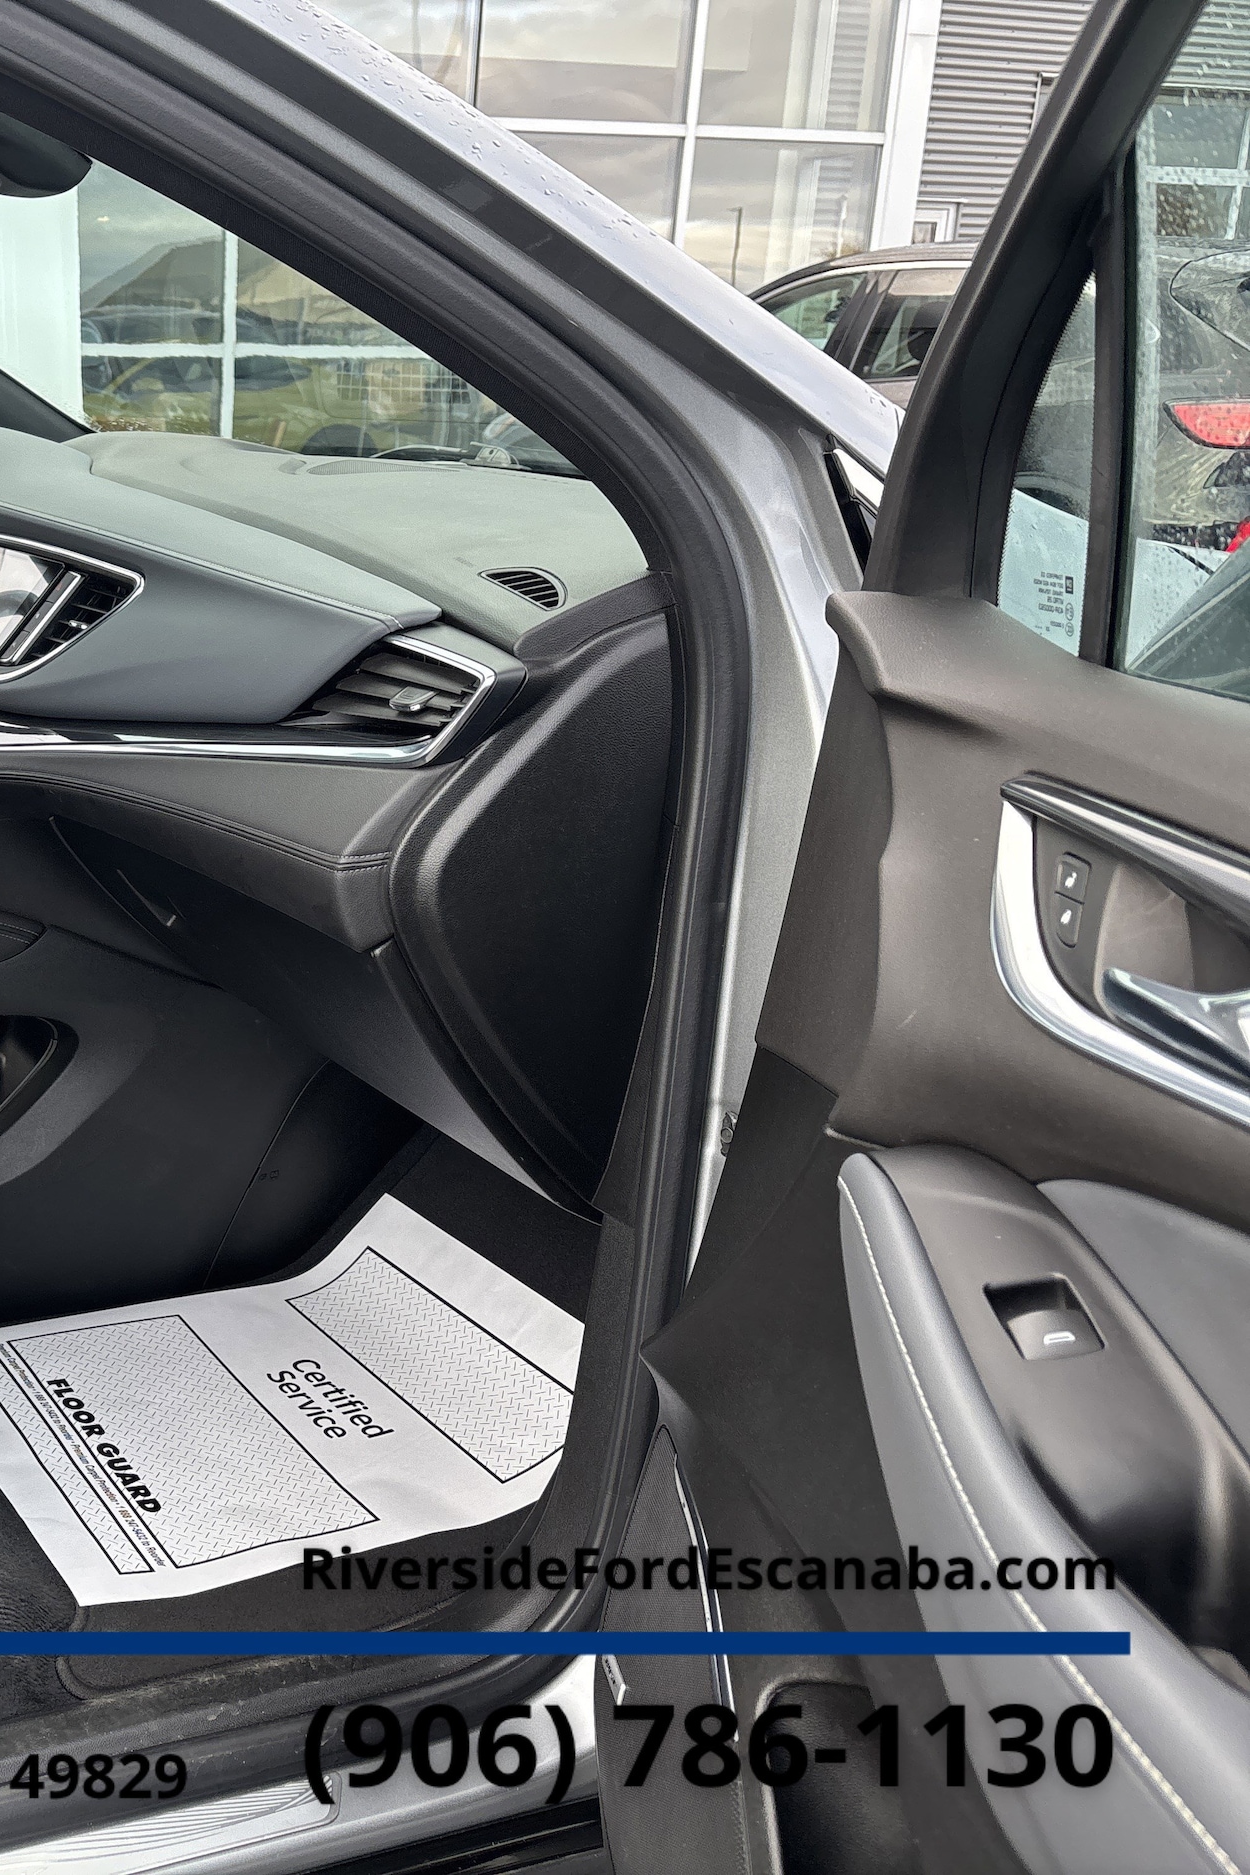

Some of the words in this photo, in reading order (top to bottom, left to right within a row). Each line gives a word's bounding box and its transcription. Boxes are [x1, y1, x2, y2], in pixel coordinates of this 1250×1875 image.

[266, 1370, 347, 1439] Service
[292, 1359, 395, 1438] Certified
[46, 1378, 105, 1438] FLOOR
[96, 1442, 162, 1513] GUARD
